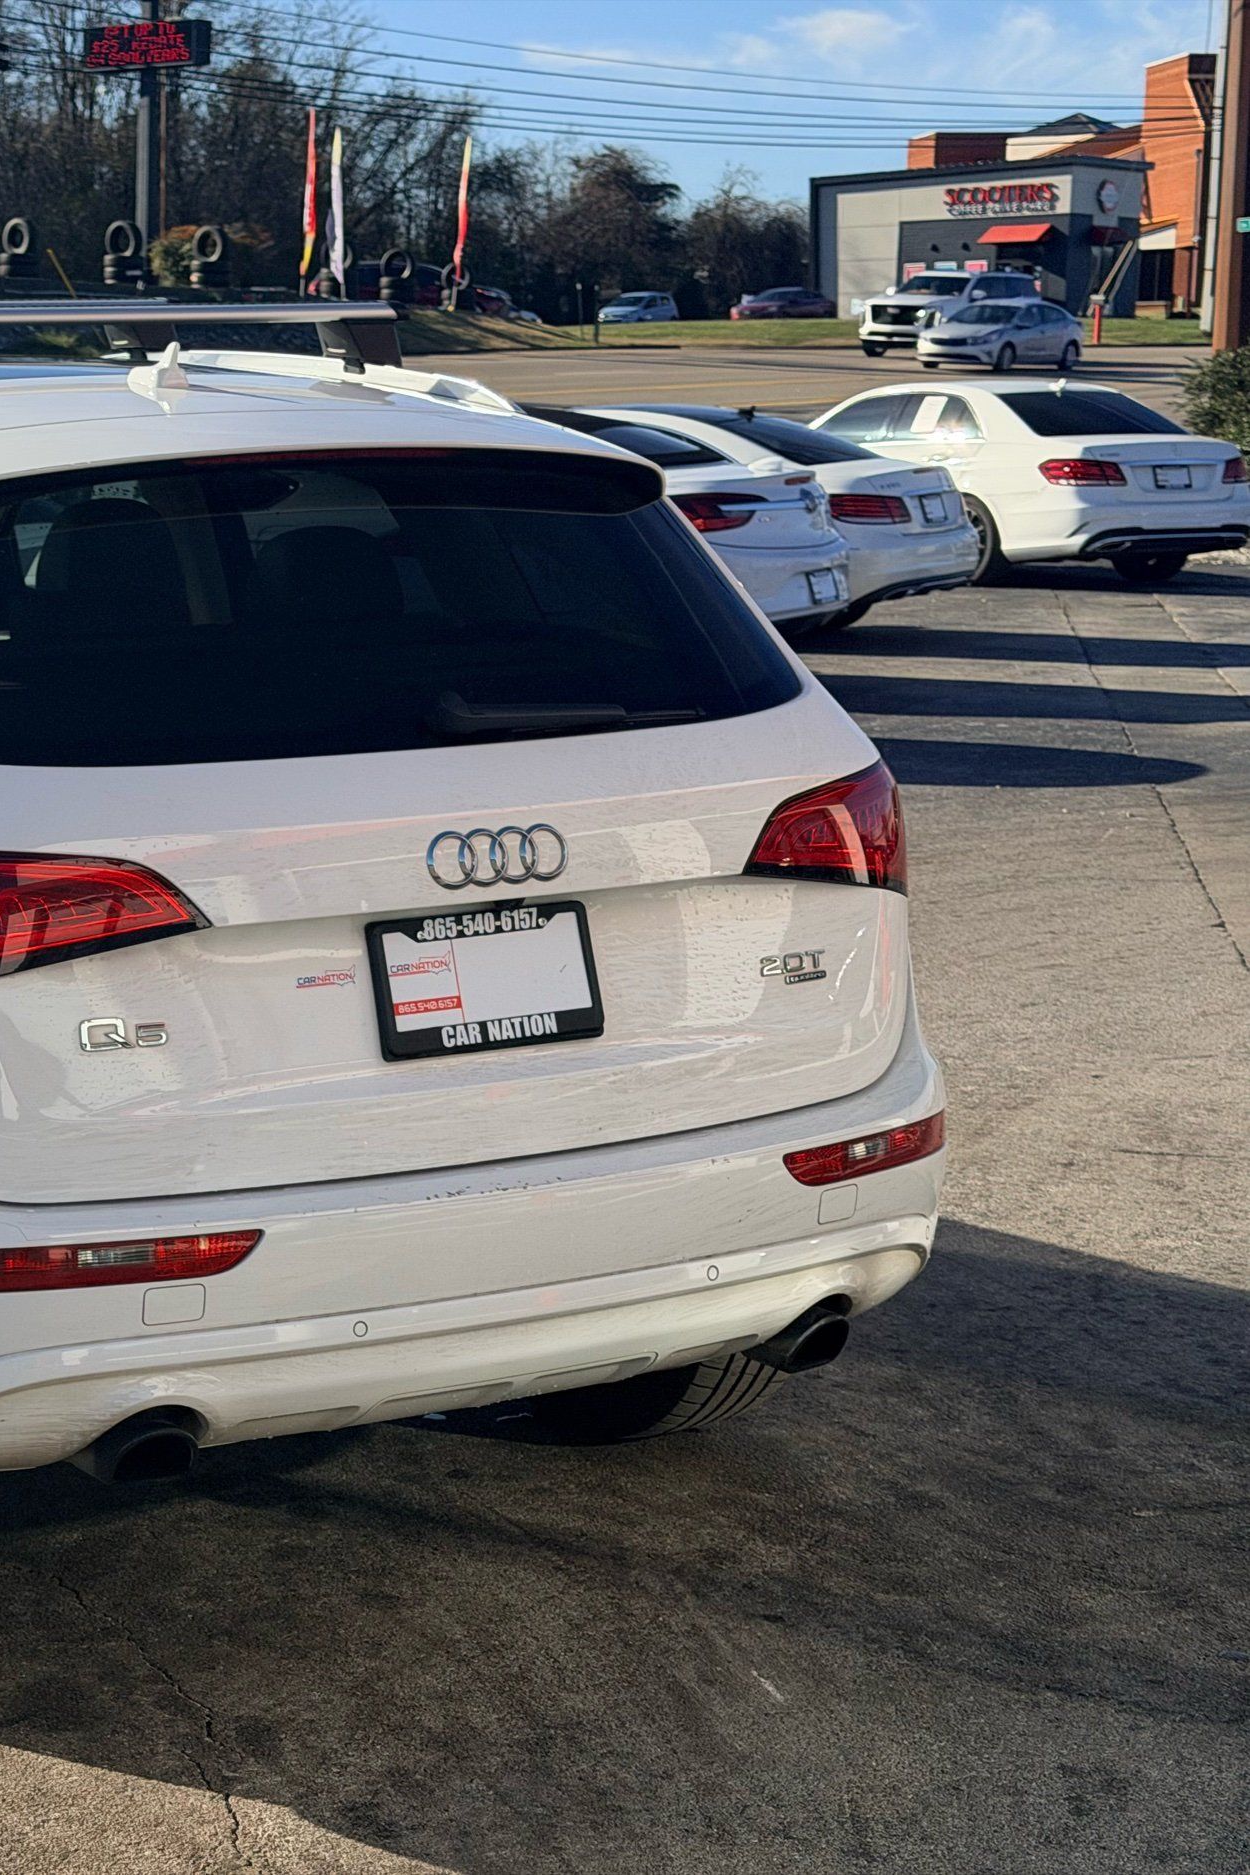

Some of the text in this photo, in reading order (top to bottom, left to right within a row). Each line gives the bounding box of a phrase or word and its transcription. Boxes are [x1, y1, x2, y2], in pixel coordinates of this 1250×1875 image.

[422, 907, 539, 941] 865-540-6157
[398, 998, 459, 1015] 865.540.6157
[441, 1012, 559, 1048] CAR NATION
